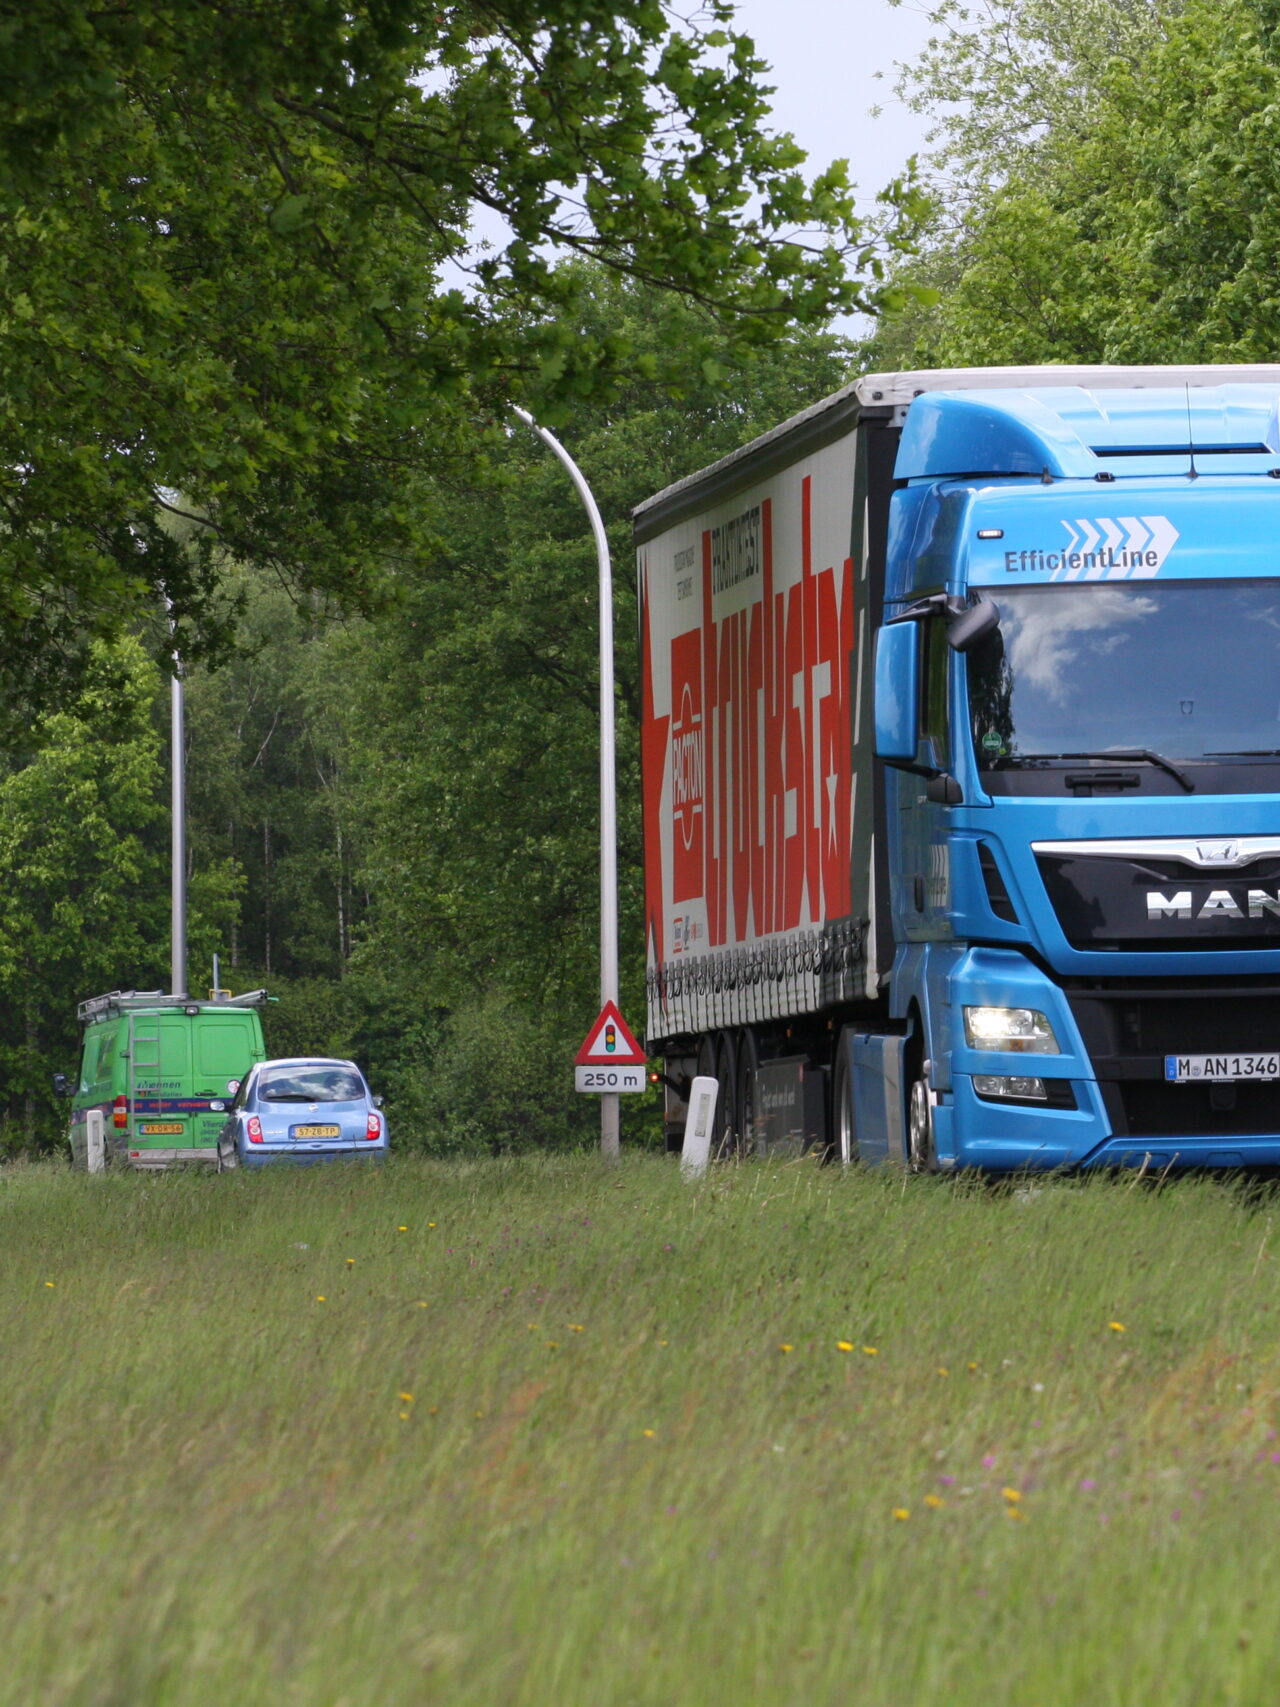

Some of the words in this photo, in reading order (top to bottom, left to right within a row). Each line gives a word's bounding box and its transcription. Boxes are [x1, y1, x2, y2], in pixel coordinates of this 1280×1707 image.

[1004, 547, 1159, 573] EfficientLine
[672, 729, 702, 806] PACTON
[1179, 1058, 1191, 1078] M
[584, 1073, 618, 1087] 250
[624, 1076, 638, 1087] m
